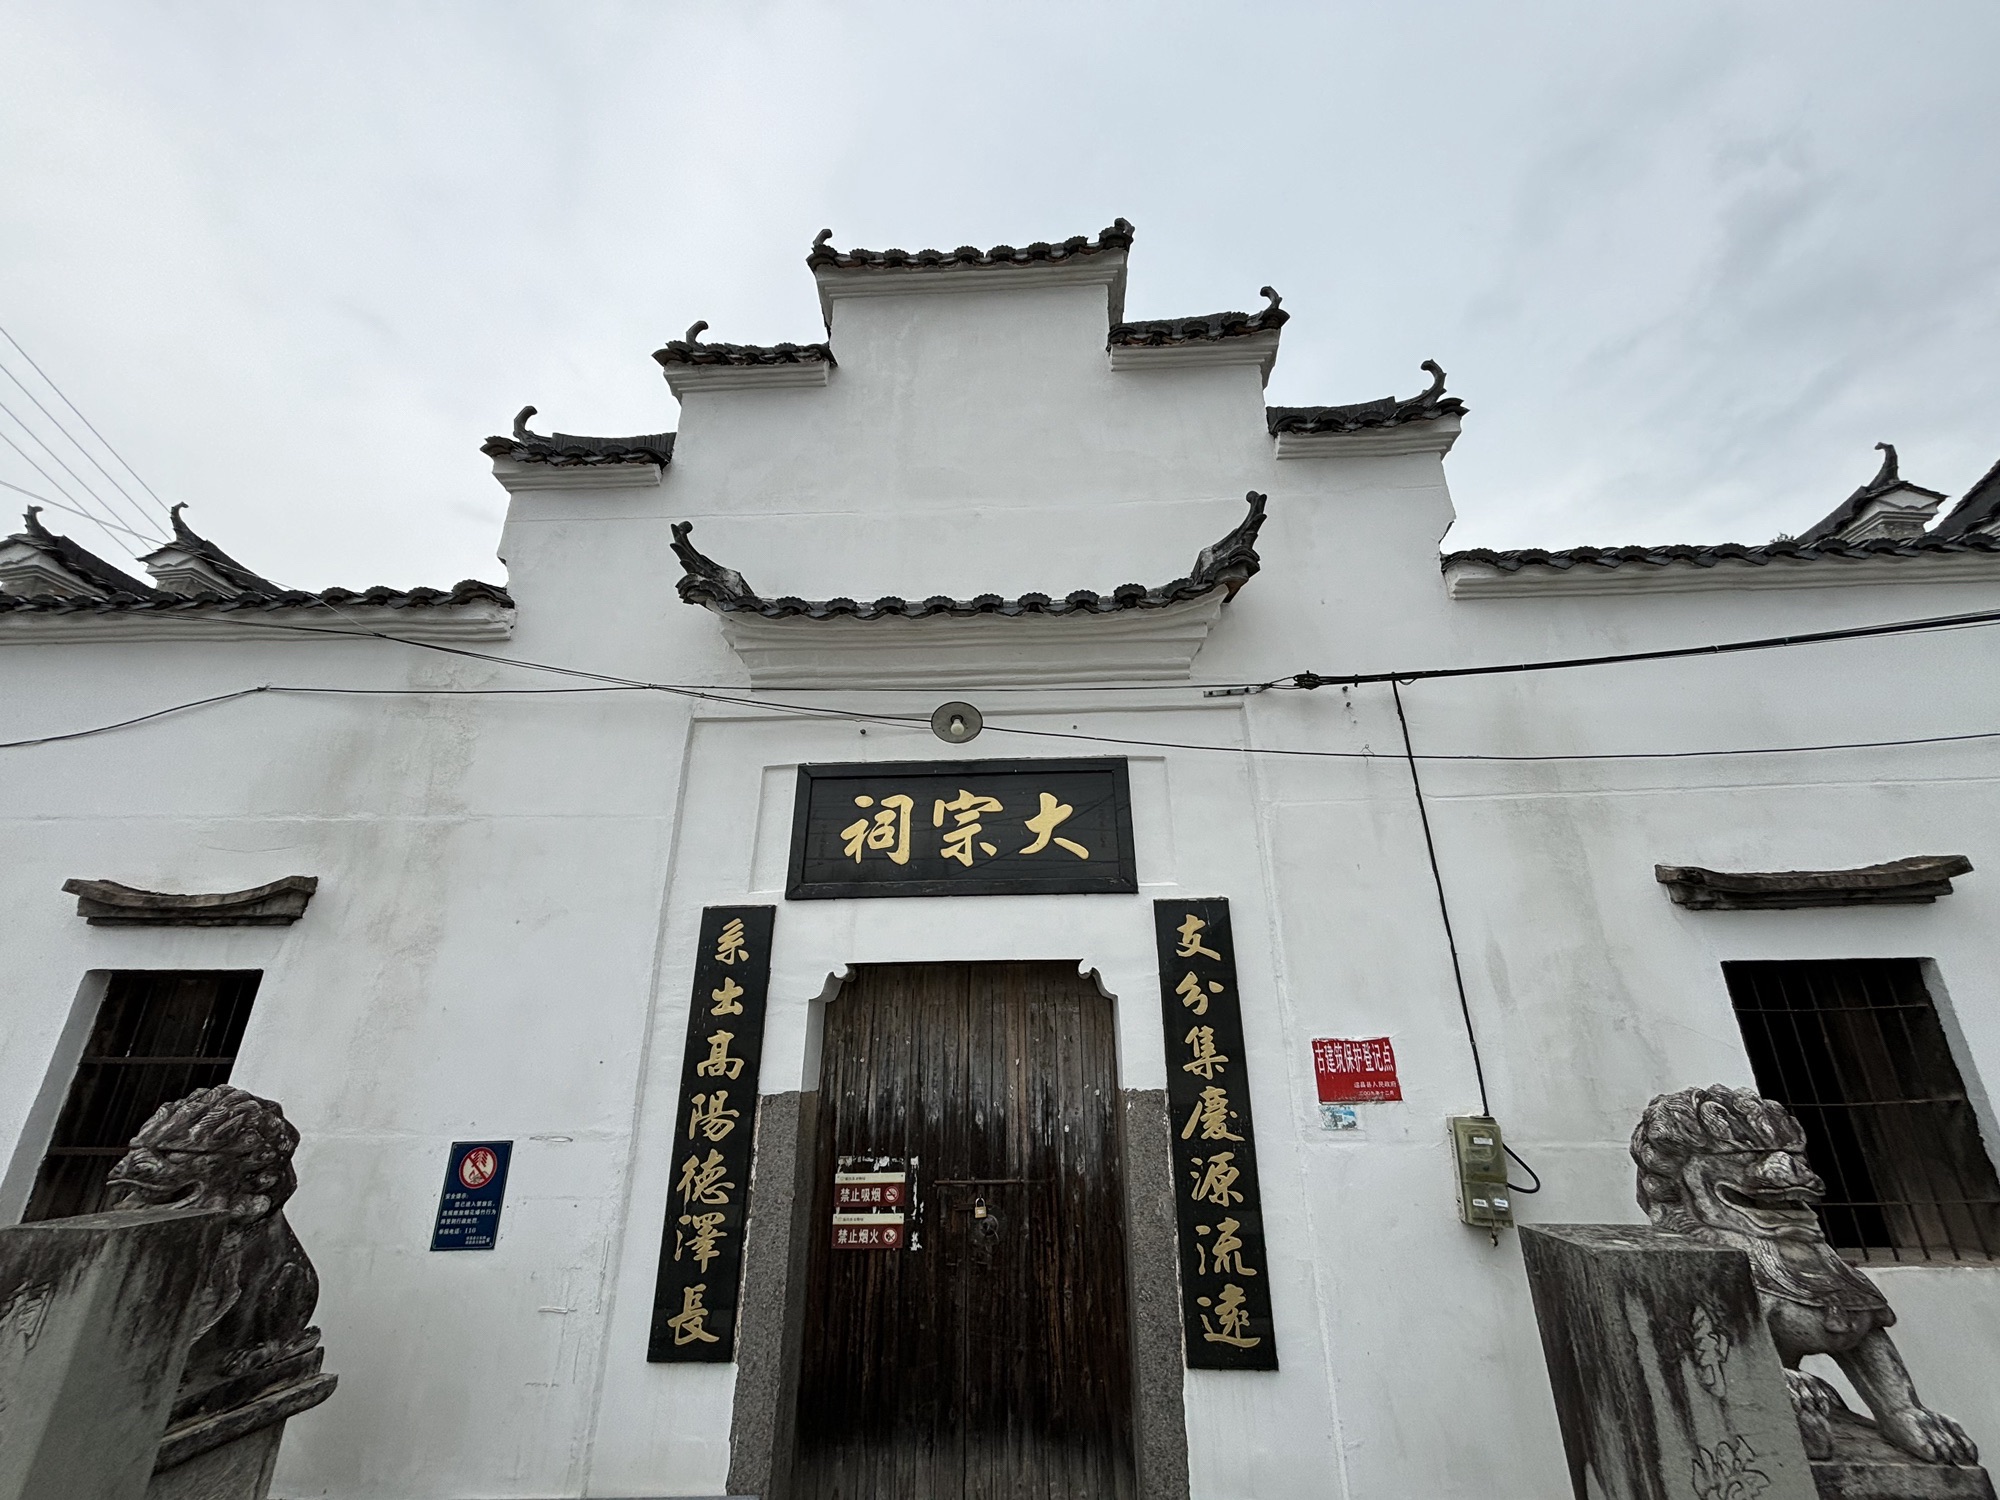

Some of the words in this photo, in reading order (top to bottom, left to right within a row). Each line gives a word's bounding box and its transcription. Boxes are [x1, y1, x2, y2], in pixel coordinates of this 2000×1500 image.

[841, 790, 1089, 867] 大宗祠
[1315, 1042, 1393, 1073] 古建筑保护登记点
[840, 1188, 881, 1202] 禁止吸烟
[838, 1229, 879, 1244] 禁止烟火
